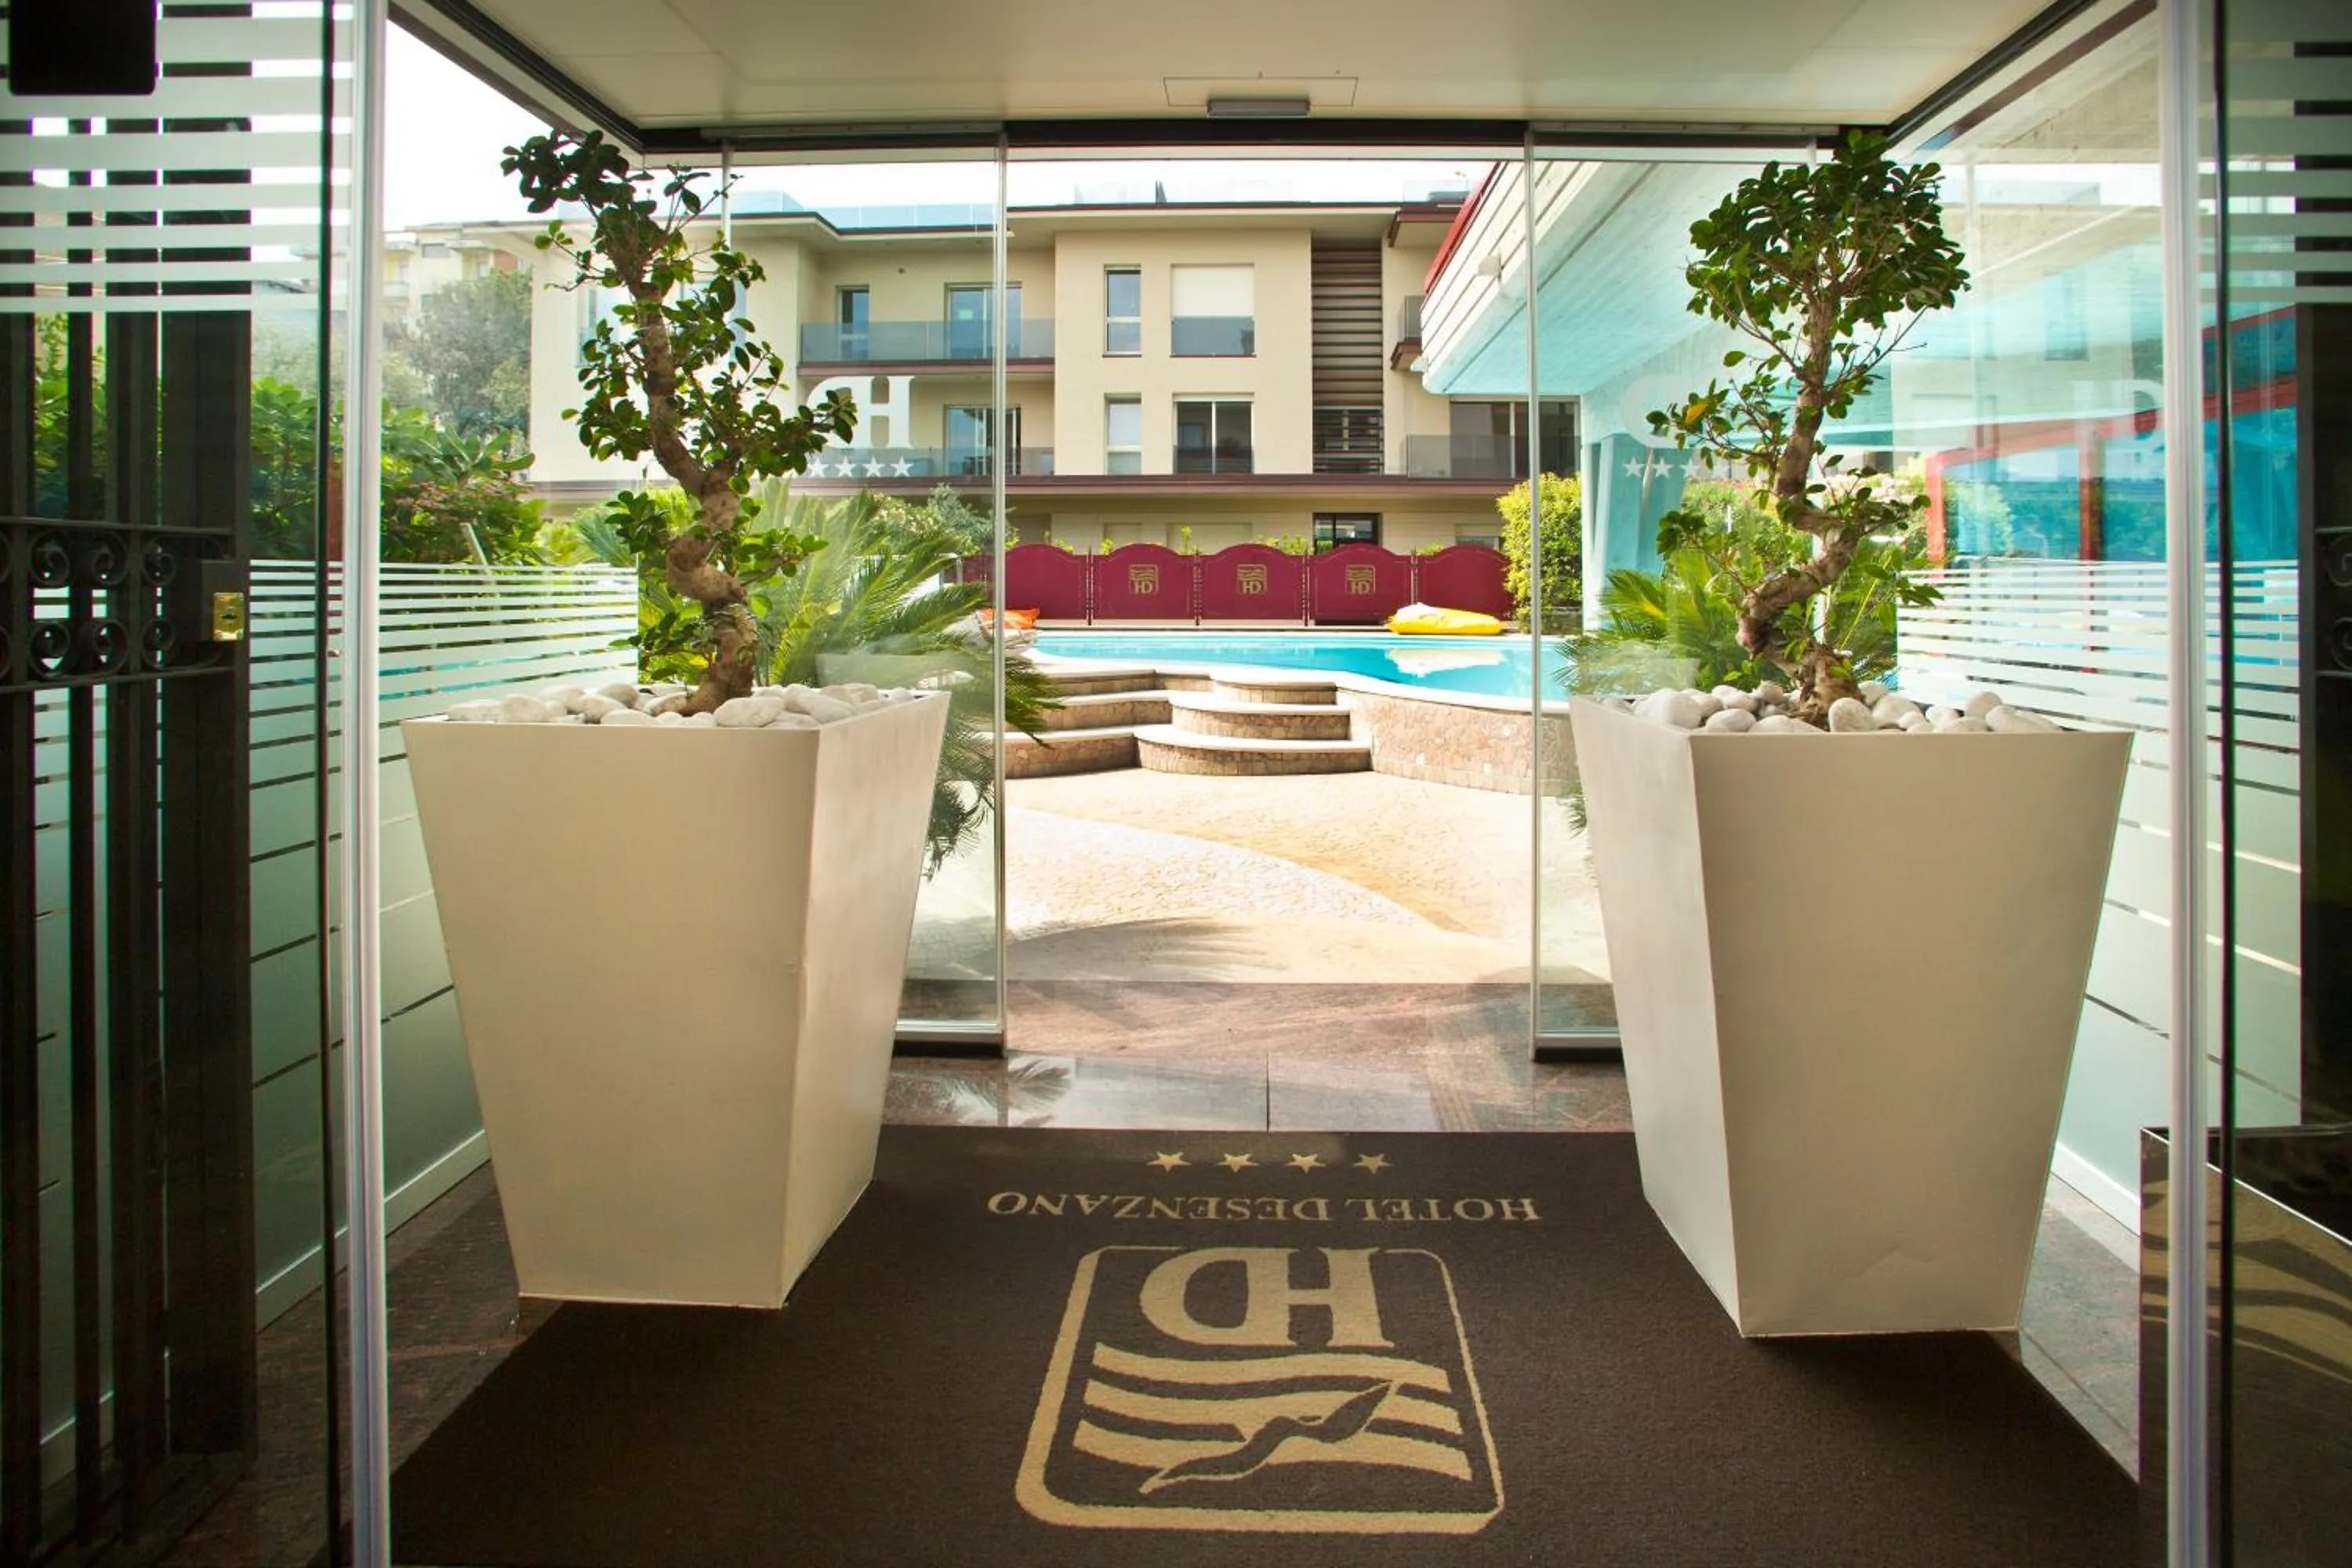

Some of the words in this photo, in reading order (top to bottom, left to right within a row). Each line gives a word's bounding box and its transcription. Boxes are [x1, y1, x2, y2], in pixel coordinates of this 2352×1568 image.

[1134, 581, 1153, 594] HD
[1243, 581, 1261, 594] HD
[1351, 581, 1370, 594] HD
[987, 1192, 1332, 1221] DESENZANO
[1345, 1197, 1541, 1221] HOTEL
[1139, 1246, 1396, 1348] HD
